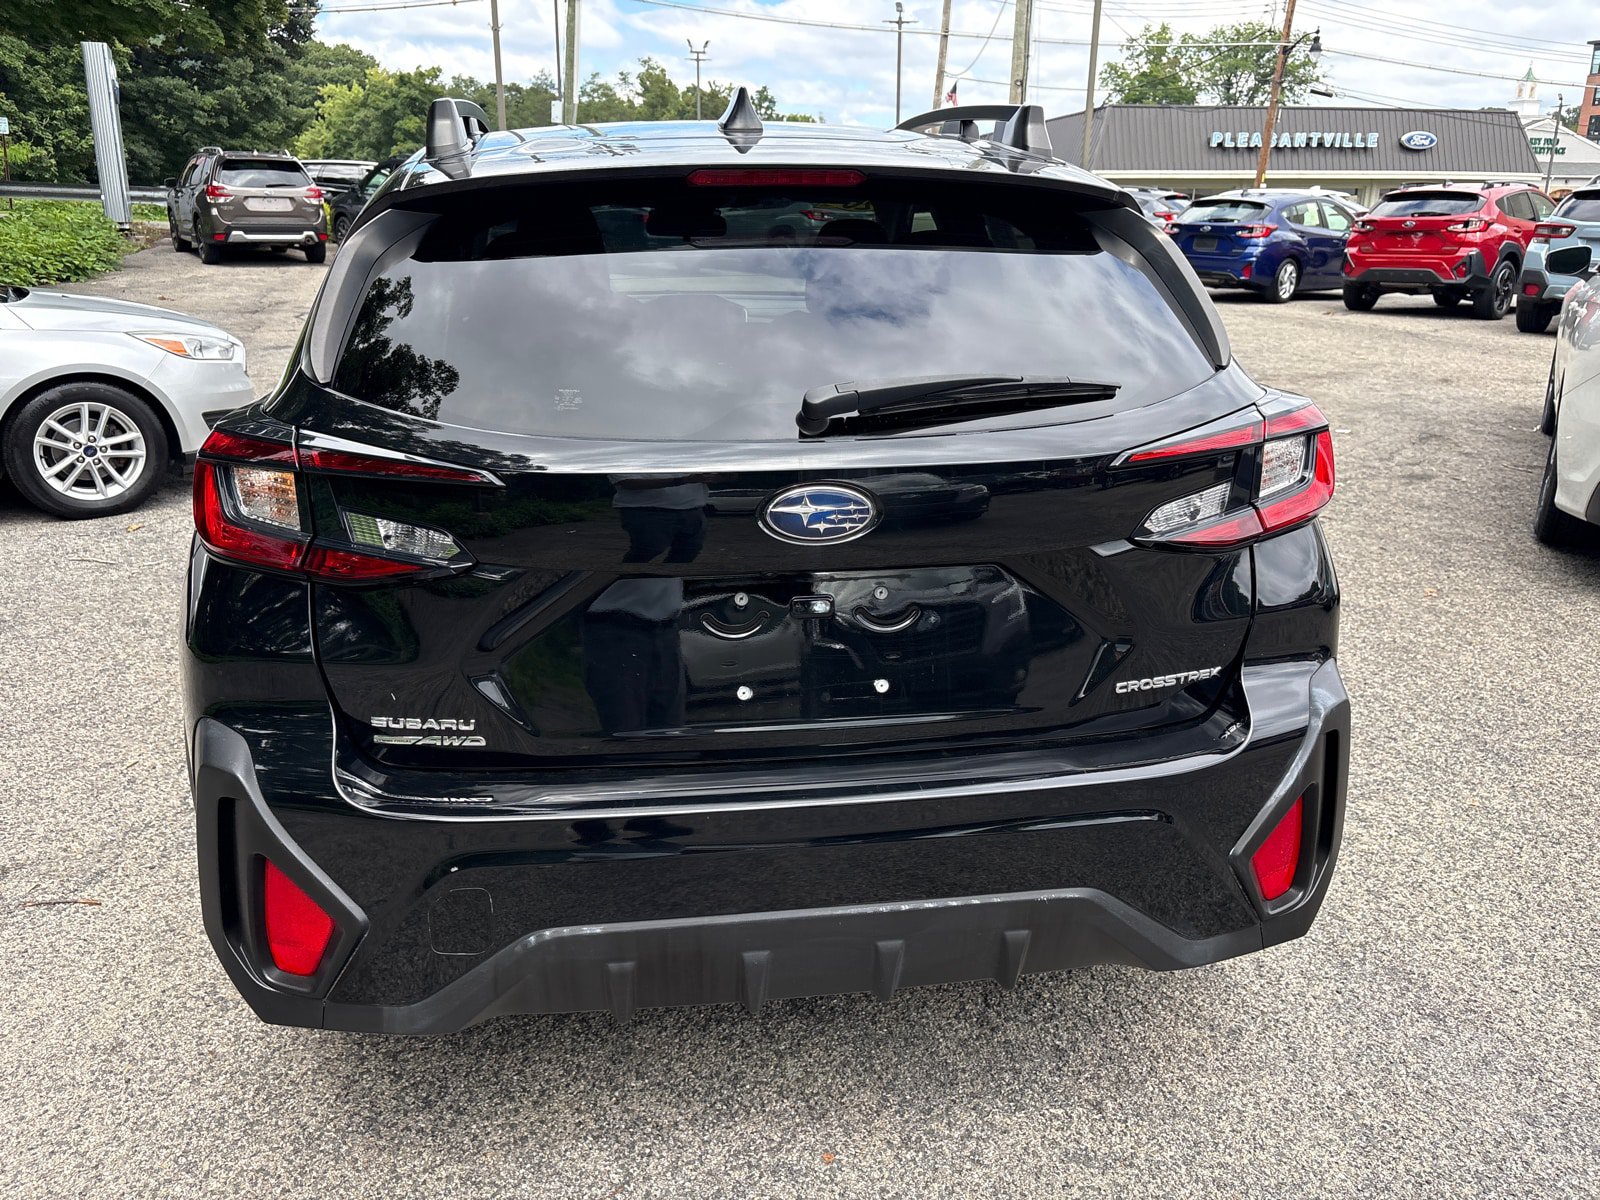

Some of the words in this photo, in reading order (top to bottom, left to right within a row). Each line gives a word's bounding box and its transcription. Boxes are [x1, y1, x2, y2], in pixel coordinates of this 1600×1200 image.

[1115, 666, 1222, 694] CROSSTREK
[370, 716, 476, 731] SUBARU
[415, 735, 487, 747] AWD
